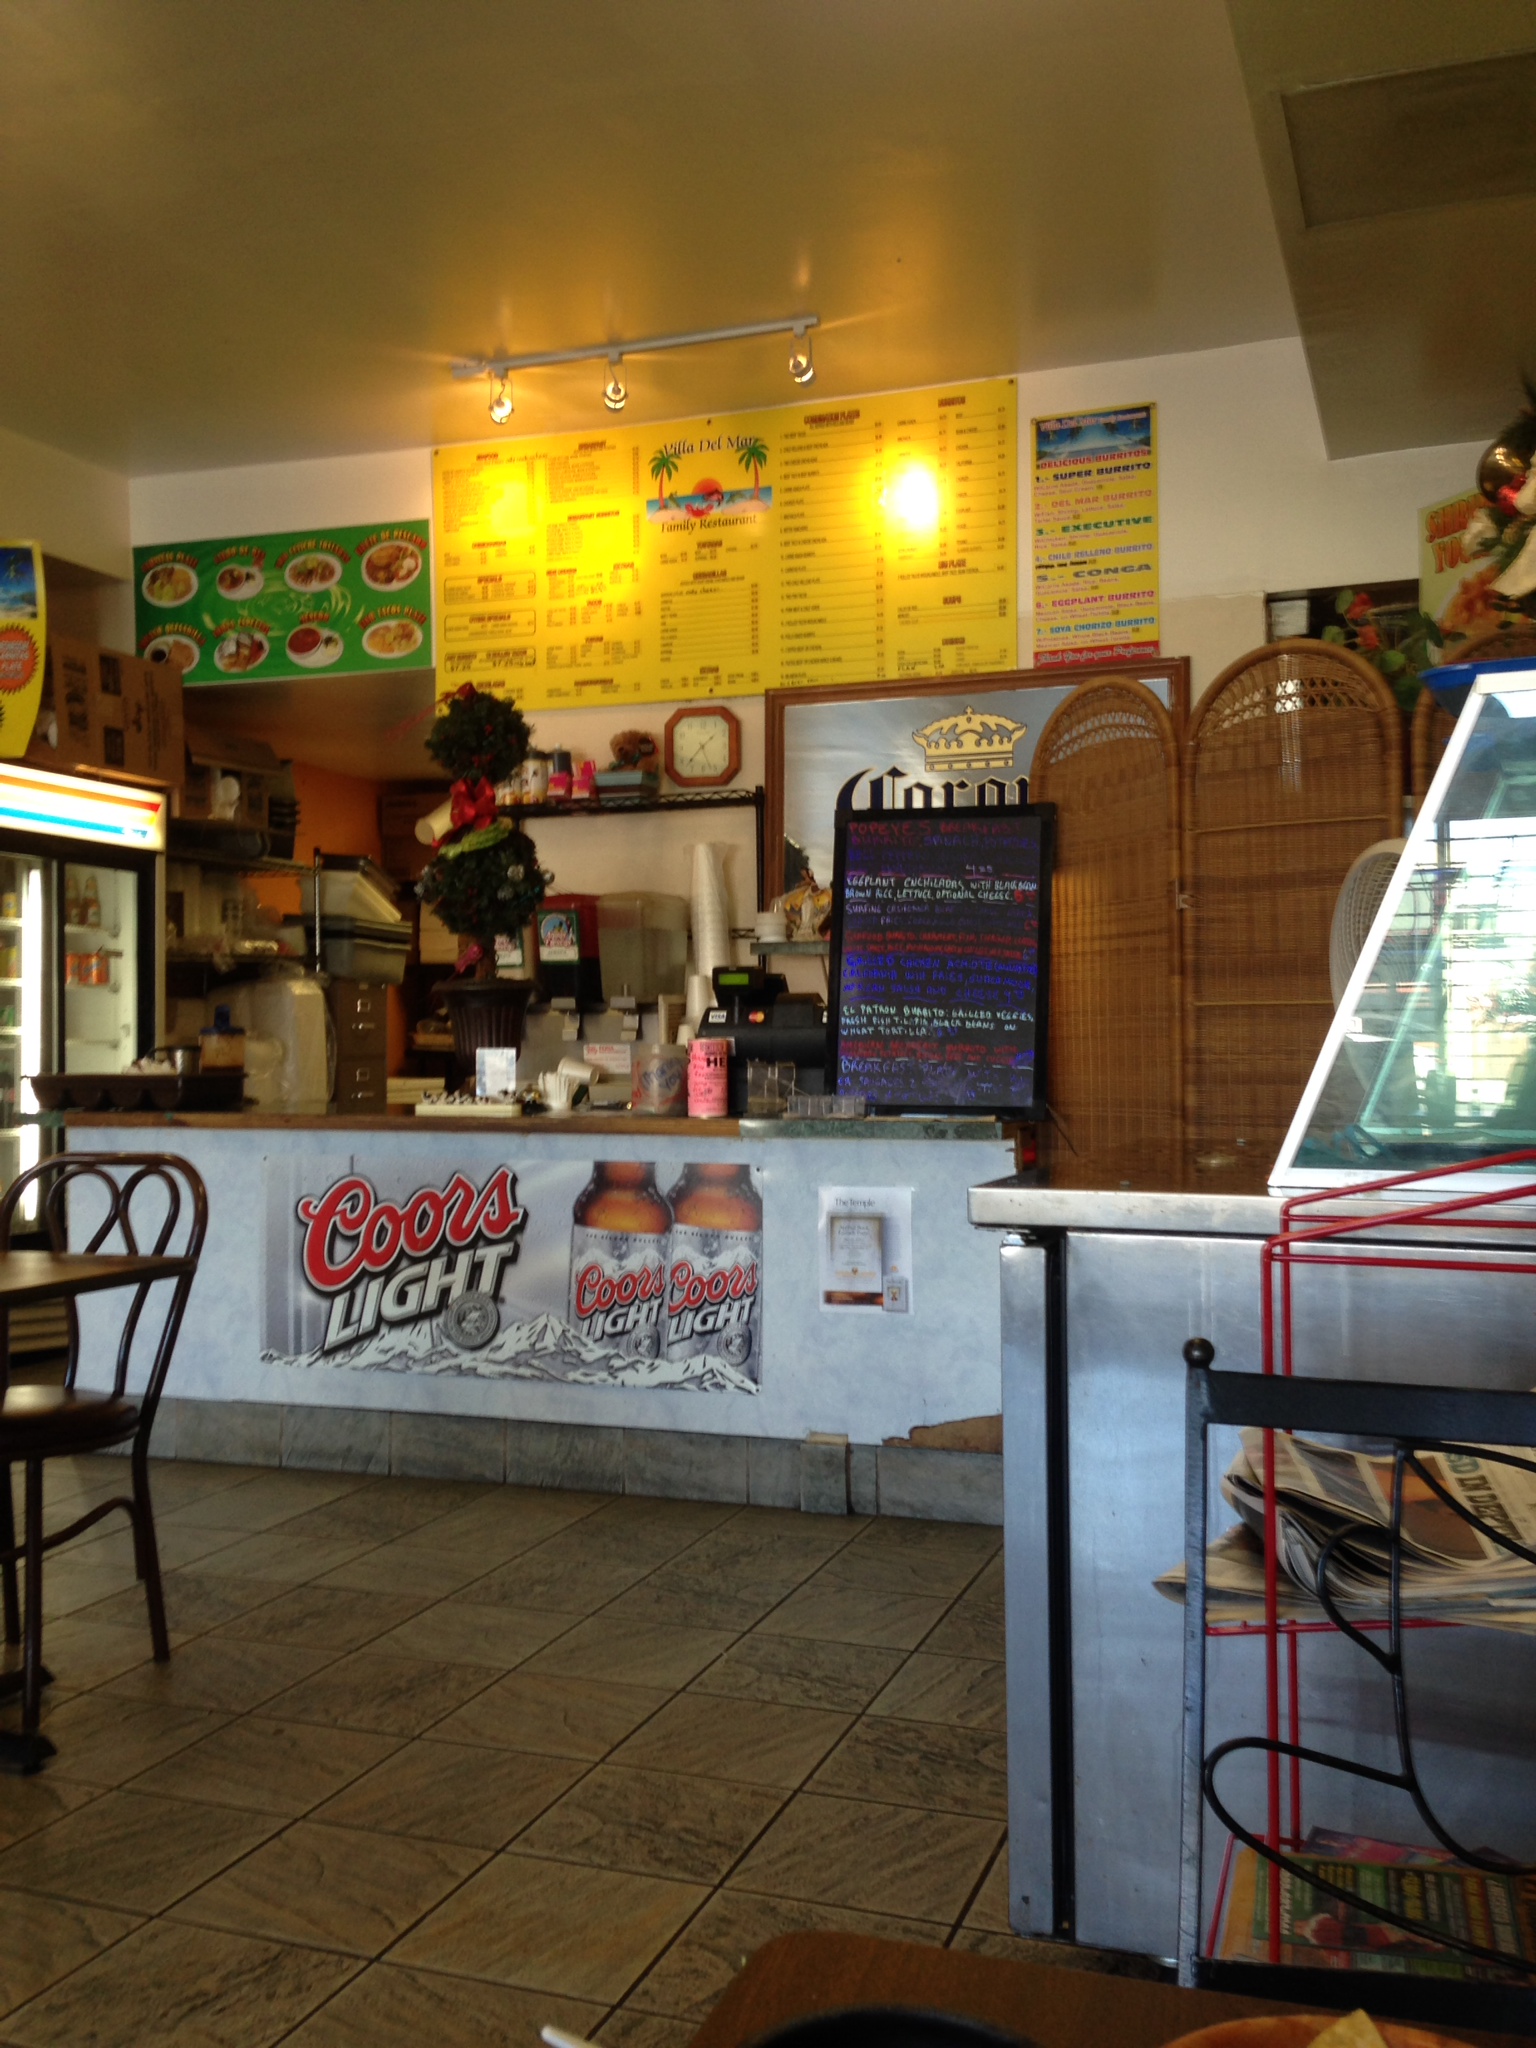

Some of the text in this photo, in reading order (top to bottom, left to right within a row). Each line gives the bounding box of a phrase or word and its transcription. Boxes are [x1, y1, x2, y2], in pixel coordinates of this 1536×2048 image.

[664, 434, 754, 457] Villa Del Mar
[1040, 448, 1149, 470] DELICIOUS BURRITOS
[1053, 470, 1092, 481] SUPER
[1096, 462, 1151, 476] BURRITO
[1052, 499, 1071, 509] DEL
[1075, 496, 1099, 506] MAR
[1103, 489, 1153, 502] BURRITO
[662, 514, 757, 536] Family Restaurant
[1061, 516, 1153, 533] EXECUTIVE
[1048, 552, 1072, 561] CHILE
[1074, 548, 1112, 558] RELLENO
[1114, 543, 1153, 554] BURRITO
[1072, 563, 1152, 578] CONGA
[1052, 595, 1105, 607] EGGPLANT
[1108, 590, 1155, 602] BURRITO
[1050, 625, 1071, 635] SOYA
[1074, 621, 1112, 632] CHORIZO
[1115, 617, 1155, 628] BURRITO
[847, 875, 896, 887] EGGPLANT
[970, 880, 992, 890] WITH
[845, 888, 872, 899] BROWN
[843, 1005, 855, 1016] EL
[860, 1004, 896, 1015] PATRON
[952, 1008, 992, 1019] GRILLED
[841, 1026, 875, 1036] WHEAT
[872, 1016, 891, 1026] FISH
[1004, 1023, 1017, 1031] ON
[298, 1164, 527, 1296] Coors
[324, 1240, 520, 1354] LIGHT
[575, 1260, 666, 1319] Coors
[668, 1260, 758, 1318] Coors
[580, 1295, 665, 1343] LIGHT
[667, 1295, 756, 1347] LIGHT
